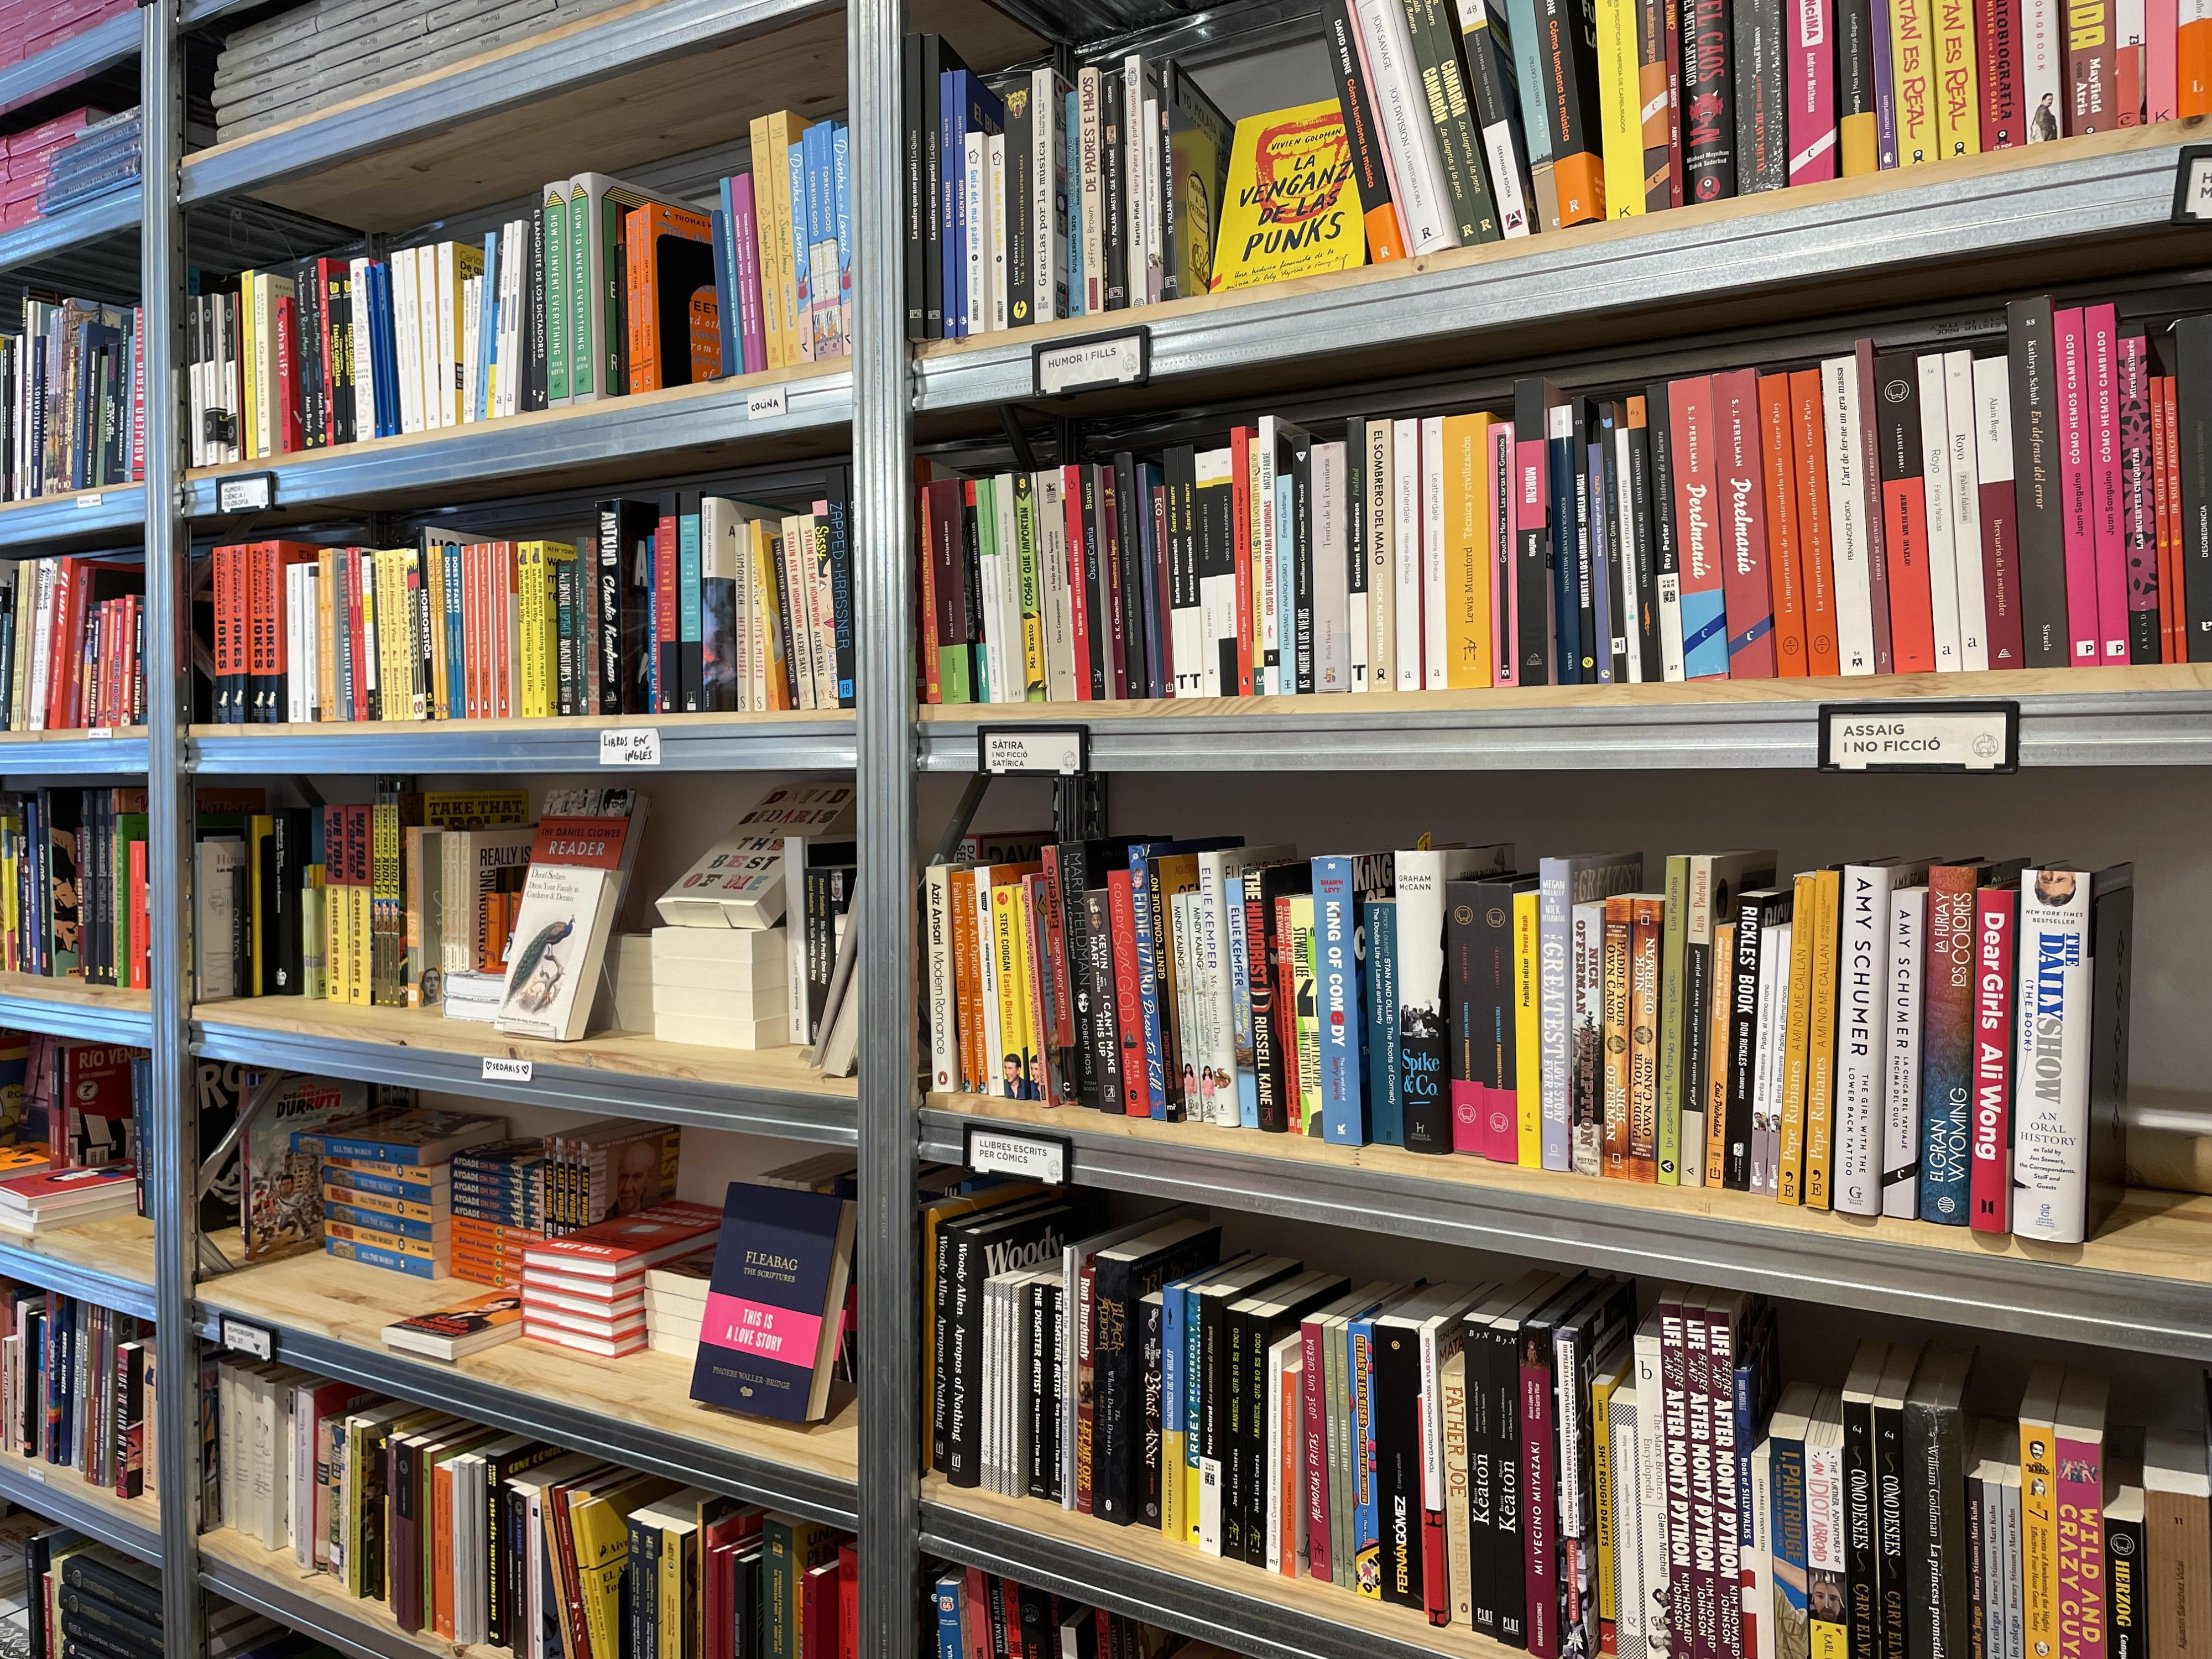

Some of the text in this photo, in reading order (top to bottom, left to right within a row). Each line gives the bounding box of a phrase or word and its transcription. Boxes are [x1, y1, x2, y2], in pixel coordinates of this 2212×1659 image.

[1697, 31, 1724, 82] CAOS
[1334, 19, 1345, 45] DAVID
[1340, 45, 1352, 75] BYRNE
[1347, 78, 1357, 101] Cómo
[1353, 102, 1365, 146] funciona
[1361, 156, 1374, 188] música
[1441, 59, 1466, 117] CAMARÓN
[1084, 128, 1095, 174] PADRES
[1271, 127, 1342, 150] VIVIEN GOLDMAN
[1293, 155, 1314, 171] LA
[1039, 196, 1045, 205] la
[1086, 177, 1096, 192] DE
[1258, 189, 1340, 226] DE LAS
[575, 233, 582, 245] TO
[1242, 211, 1345, 262] PUNKS
[576, 288, 585, 350] EVERYTHING
[1048, 354, 1082, 368] HUMOR
[1091, 348, 1116, 359] FILLS
[2065, 334, 2080, 464] CÓMO HEMOS CAMBIADO
[1374, 430, 1384, 565] EL SOMBRERO DEL MALO
[1686, 483, 1711, 579] Perelmanía
[1730, 478, 1756, 575] Perelmanía
[830, 502, 850, 650] ZAPPED KRASSNER
[602, 512, 618, 683] ANTKIND Charlie Kaufman
[421, 588, 432, 659] HORRORSTÖR
[634, 735, 649, 746] EN
[992, 739, 1023, 749] SÀTIRA
[1843, 724, 1905, 736] ASSAIG
[1844, 737, 1940, 752] I NO FICCIÓ
[992, 758, 1024, 766] SATÍRICA
[761, 789, 851, 805] DAVID
[739, 810, 839, 825] SEDARIS
[548, 841, 604, 857] READER
[1090, 936, 1099, 967] HART
[1098, 935, 1108, 969] KEVIN
[1133, 893, 1154, 995] EDDIE IZZARD
[1328, 947, 1342, 968] OF
[2065, 932, 2080, 967] THE
[931, 883, 945, 1054] Aziz Ansari Modern Romance
[1588, 947, 1599, 989] NICK
[1851, 877, 1874, 1056] AMY SCHUMER
[1244, 872, 1272, 1105] THE HUMORIST RUSSELL KANE
[1543, 943, 1565, 1061] GREATEST
[1738, 974, 1755, 1014] BOOK
[1575, 920, 1593, 1147] OFFERMAN GUMPTION
[1976, 912, 2004, 1160] Dear Girls Ali Wong
[2035, 931, 2064, 1104] DAILY SHOW
[1402, 1048, 1439, 1078] Spike
[1404, 1075, 1415, 1094] &
[1949, 1088, 1967, 1182] WYOMING
[2031, 1123, 2065, 1133] ORAL
[2039, 1112, 2057, 1120] AN
[979, 1150, 1027, 1163] PER CÒMICS
[980, 1140, 1047, 1156] LLIBRES ESCRITS
[1929, 1119, 1948, 1183] EL GRAN
[2021, 1131, 2077, 1145] HISTORY
[579, 1243, 612, 1255] BELL
[745, 1251, 798, 1271] FLEABAG
[956, 1243, 967, 1282] Woody
[757, 1270, 795, 1282] SCRIPTURES
[726, 1325, 782, 1352] A LOVE STORY
[743, 1308, 774, 1329] THIS IS
[954, 1324, 966, 1373] Apropos
[955, 1375, 964, 1391] of
[1446, 1386, 1467, 1498] FATHER JOE
[1473, 1453, 1490, 1525] Keaton
[1666, 1387, 1691, 1567] AFTER MONTY PYTHON
[1782, 1464, 1803, 1562] PARTRIDGE
[1851, 1469, 1869, 1550] COMO DESEES
[1397, 1495, 1408, 1594] FERNÁNGÓMEZ
[2059, 1504, 2080, 1591] CRAZY
[1535, 1558, 1543, 1575] MI
[2080, 1508, 2100, 1643] WILD AND
[2115, 1559, 2131, 1627] HERZOG
